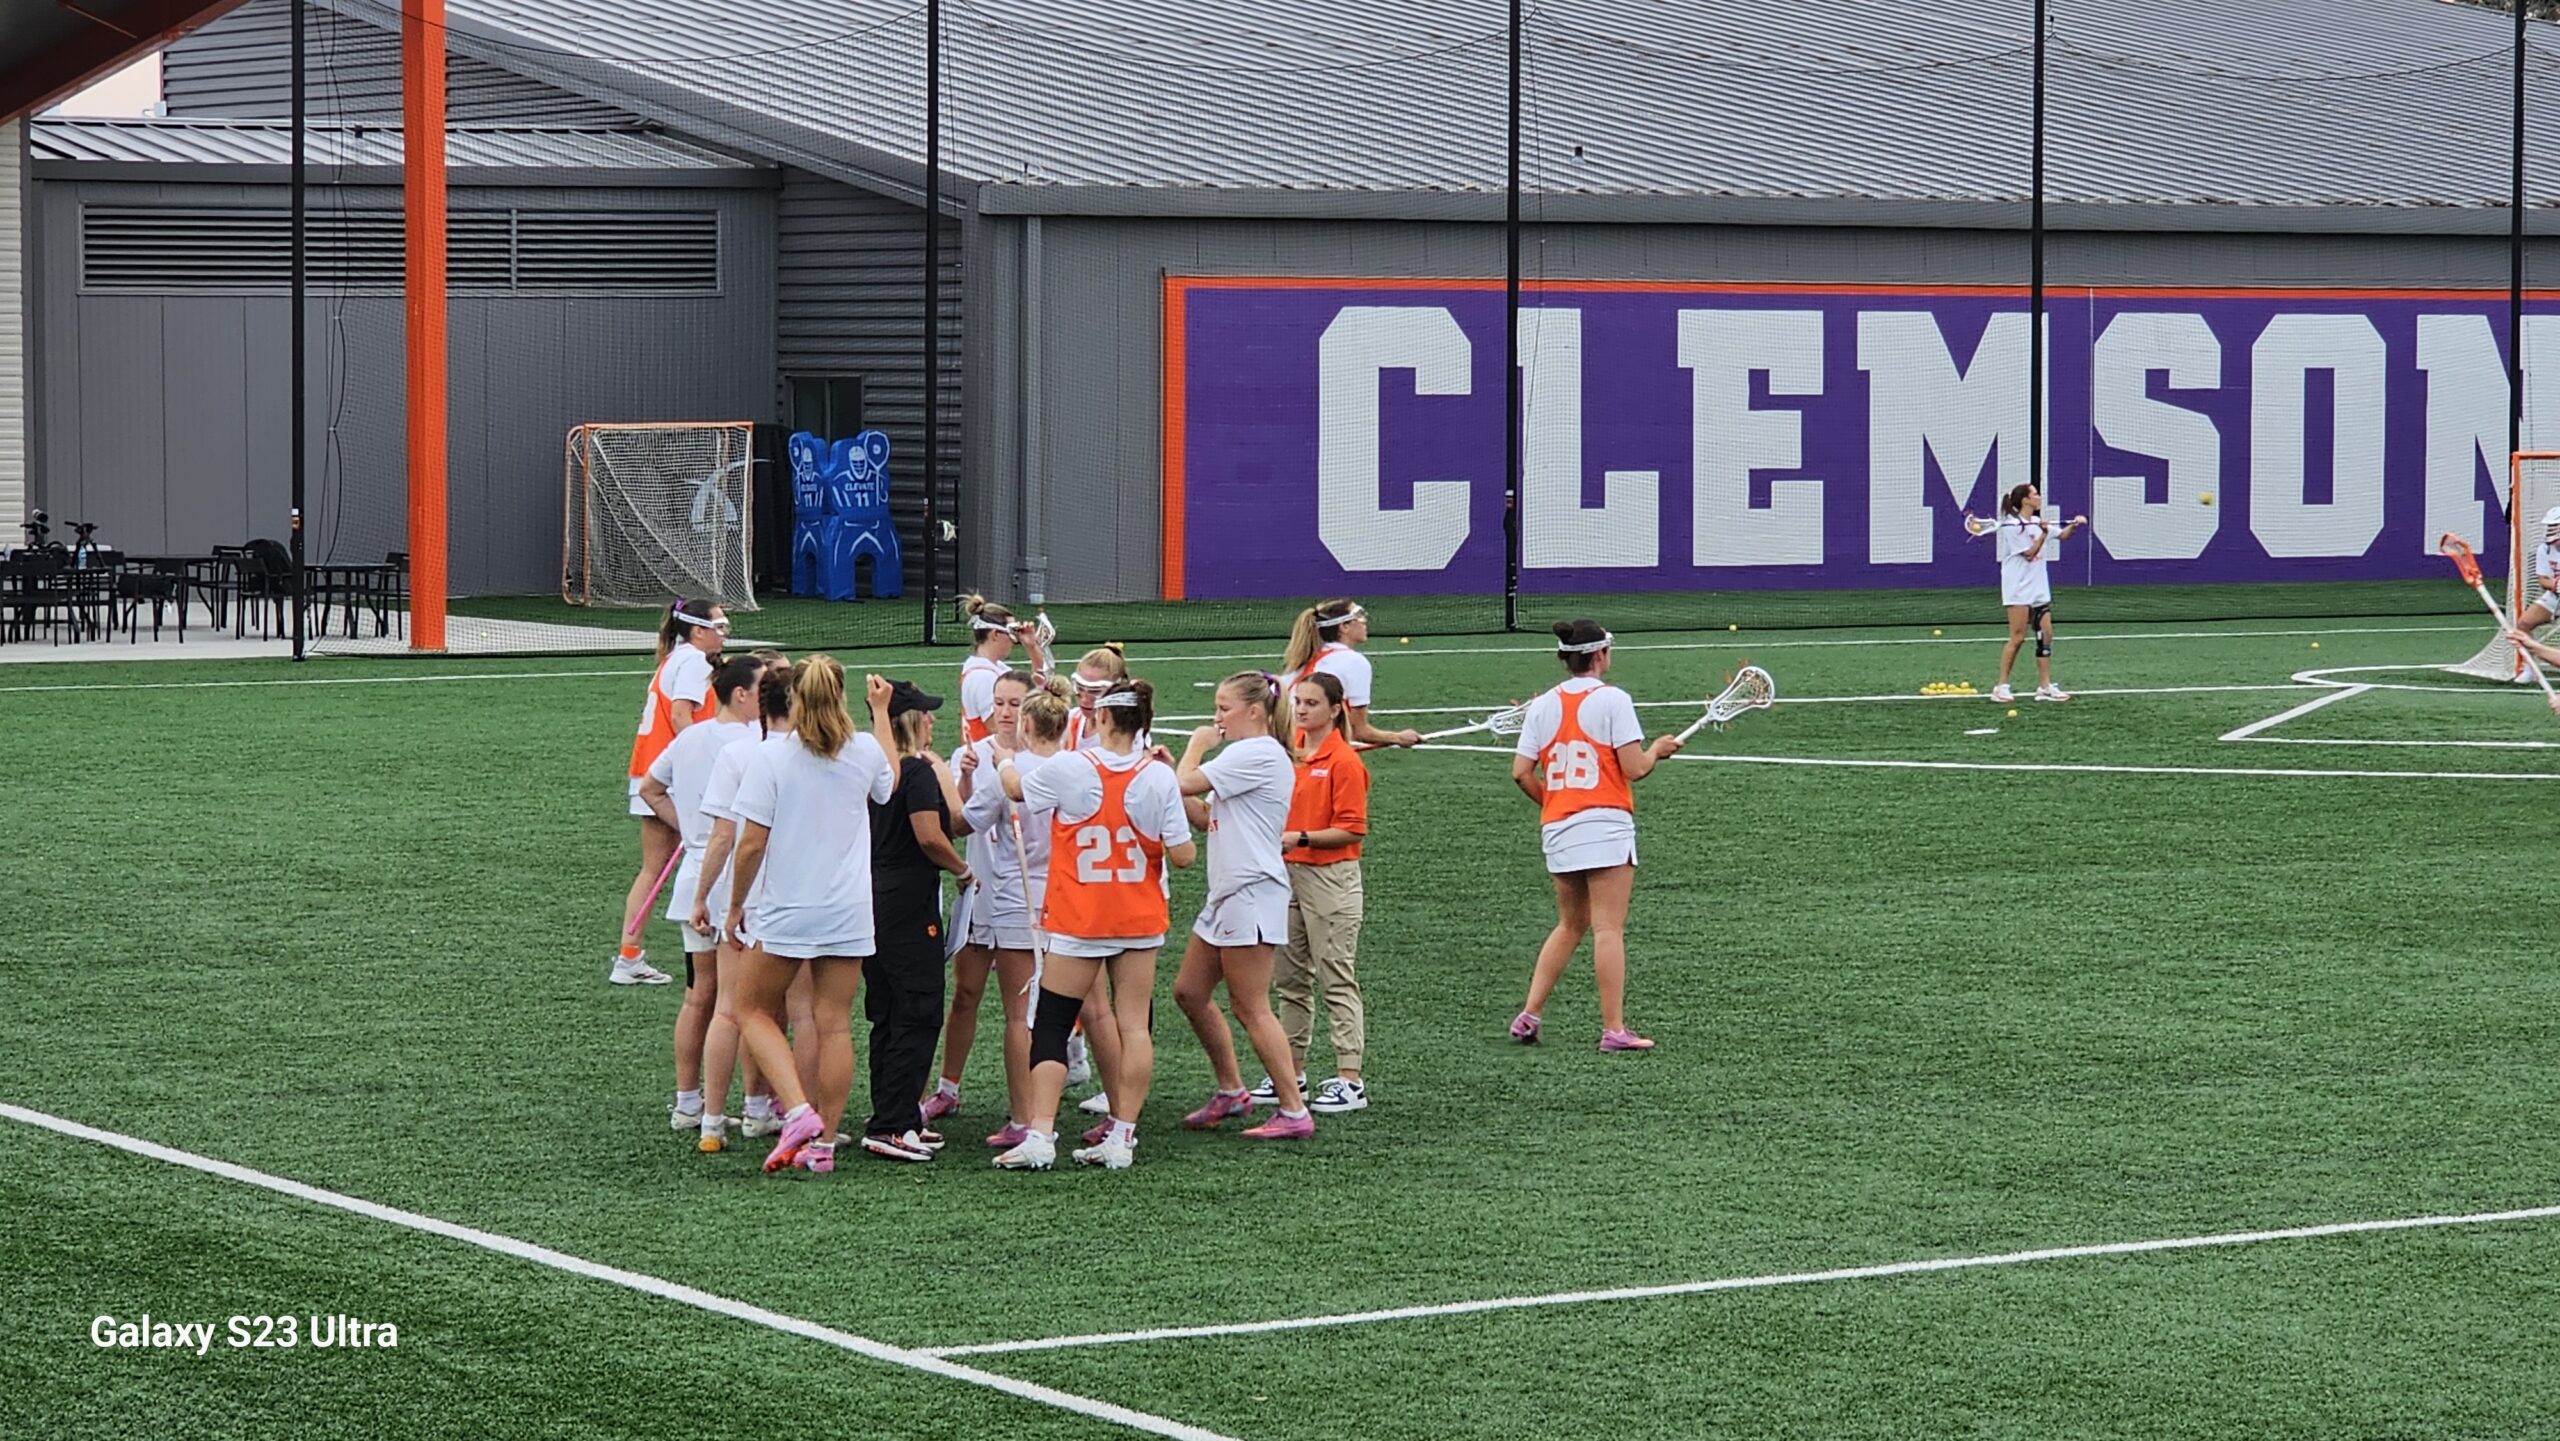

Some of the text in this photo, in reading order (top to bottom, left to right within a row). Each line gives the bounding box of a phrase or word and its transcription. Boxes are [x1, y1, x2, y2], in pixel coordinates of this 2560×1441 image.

[1318, 306, 2560, 571] CLEMSON
[855, 492, 869, 507] 11
[1546, 740, 1599, 790] 28
[1076, 825, 1147, 883] 23
